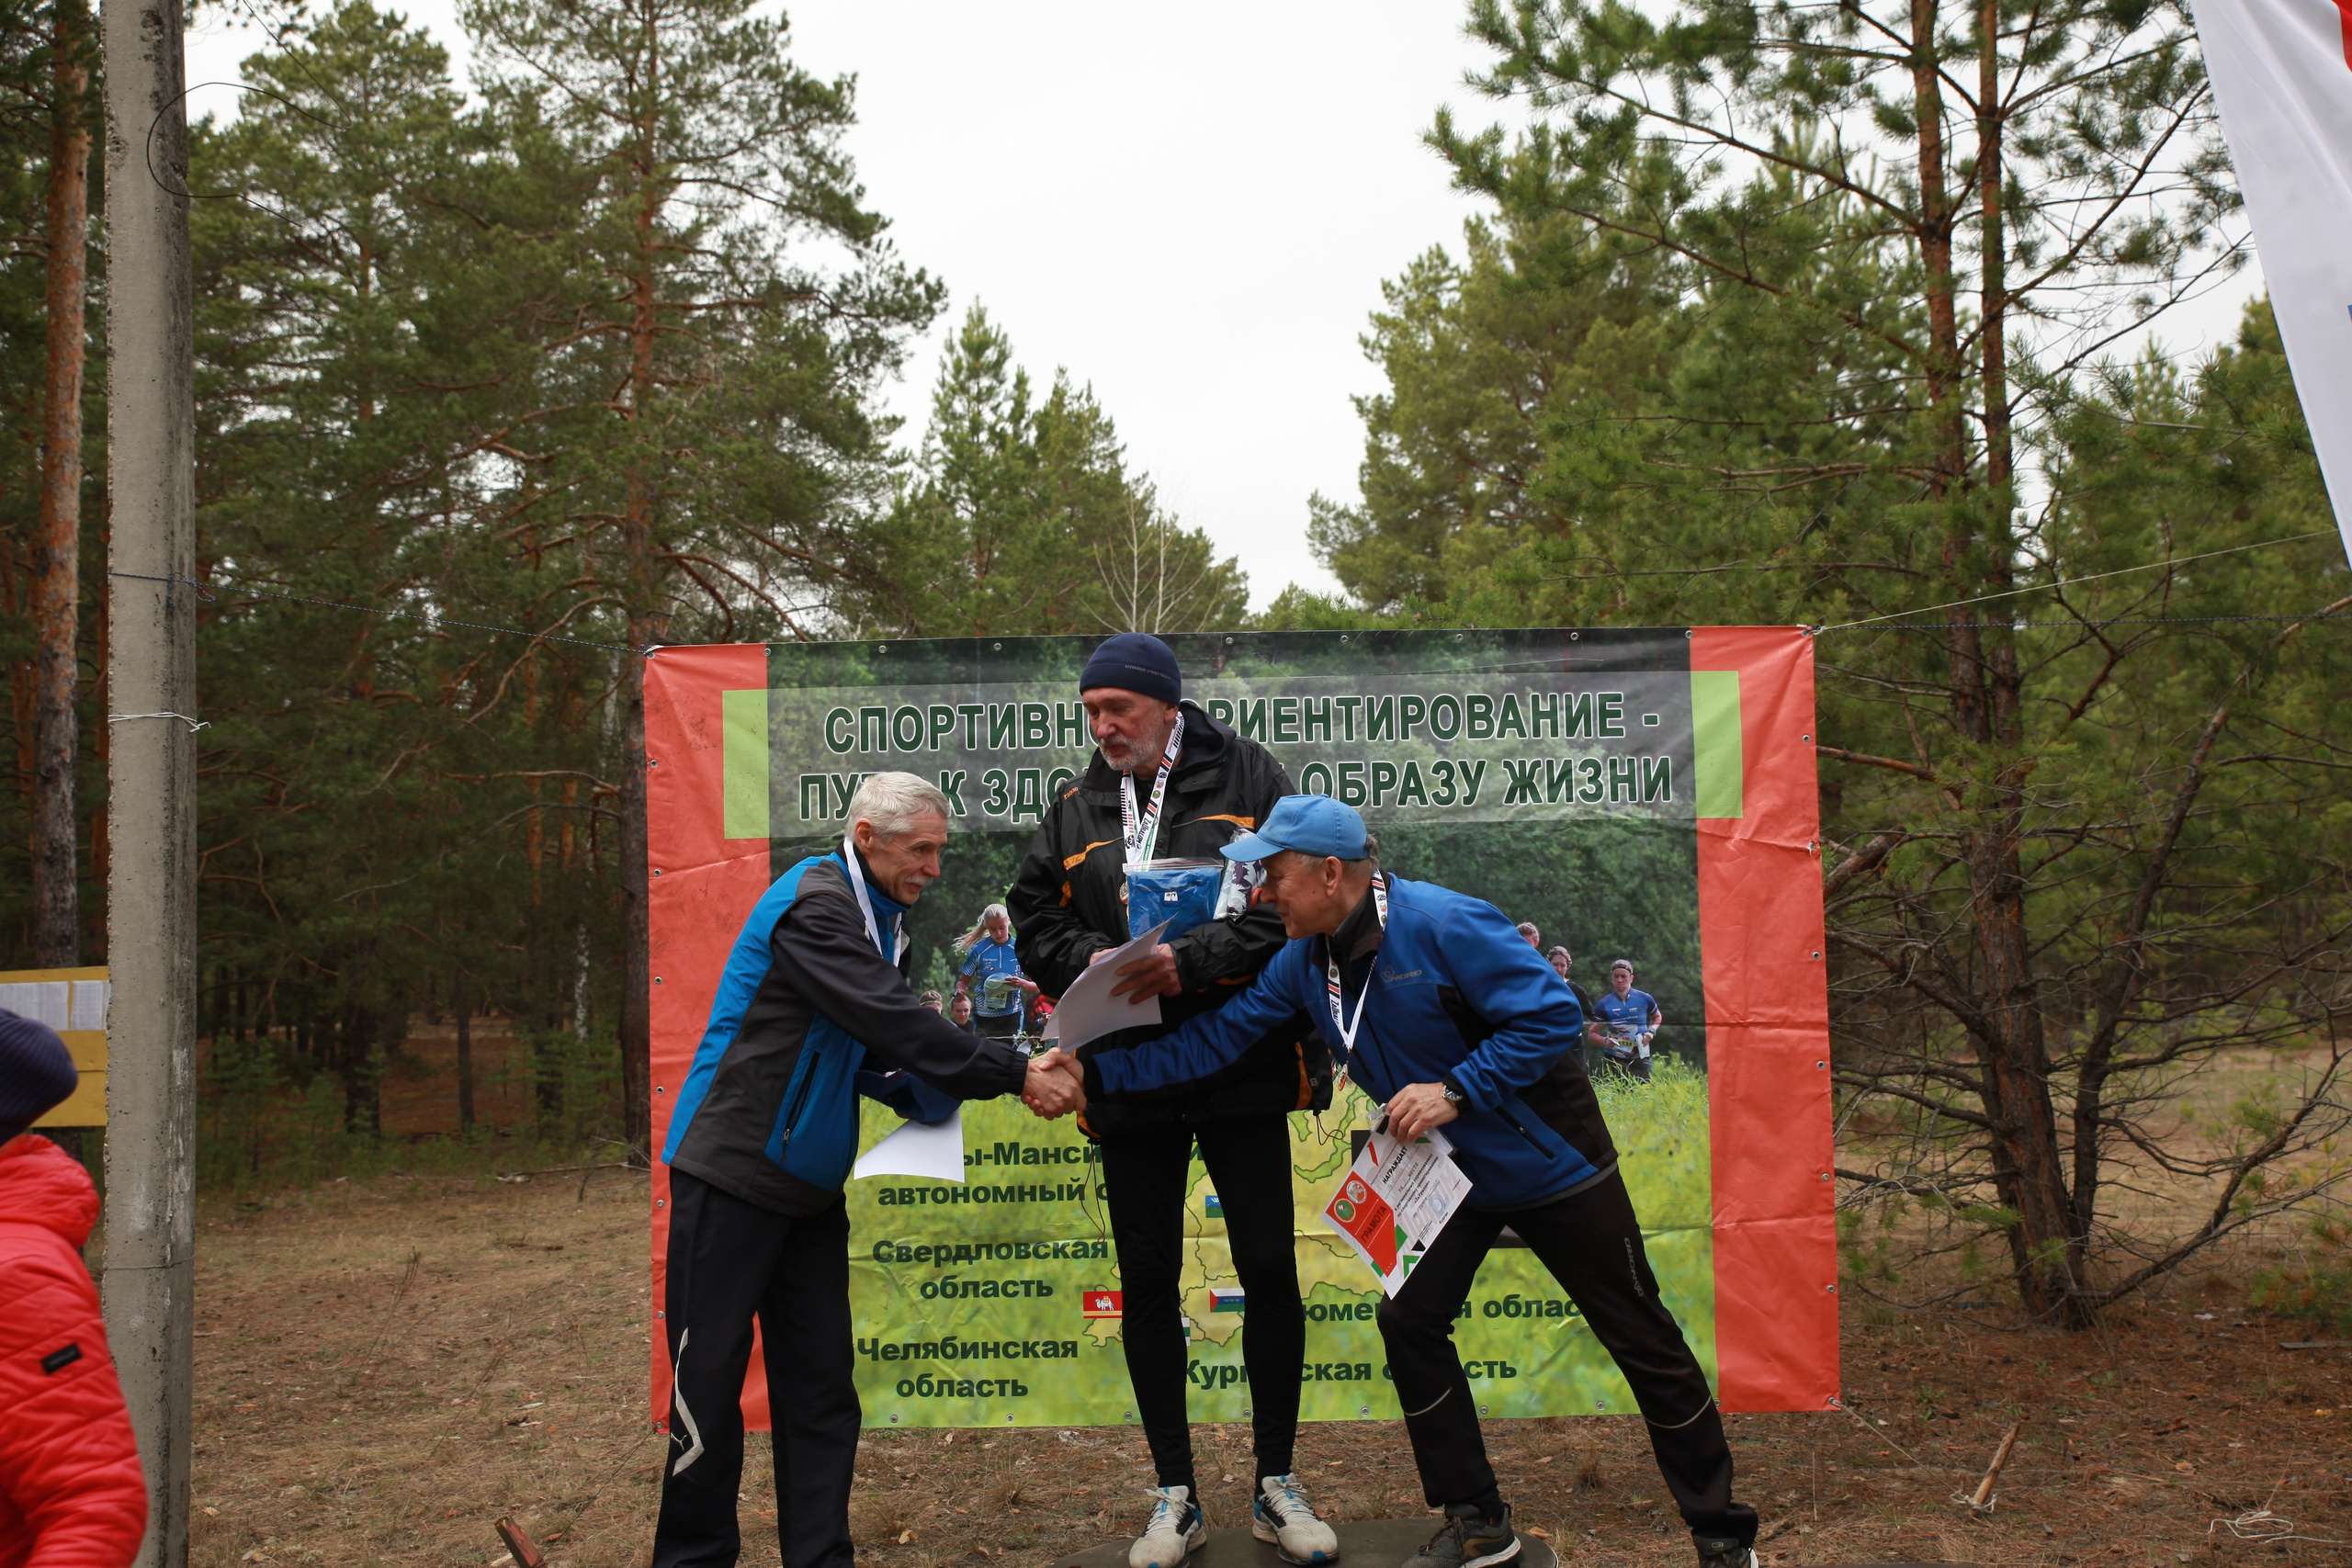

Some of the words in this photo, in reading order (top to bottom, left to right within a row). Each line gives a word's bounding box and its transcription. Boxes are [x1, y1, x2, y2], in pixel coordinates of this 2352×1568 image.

[1181, 691, 1626, 744] РИЕНТИРОВАНИЕ
[800, 773, 877, 821] ПУ
[1300, 760, 1487, 807] ОБРАЗУ
[1502, 756, 1672, 805] ЖИЗНИ
[1390, 969, 1422, 982] NORD
[1382, 1145, 1408, 1185] НАГРАЖДАЕТ
[878, 1178, 1085, 1205] автономный
[1361, 1206, 1387, 1243] ГРАМОТА
[873, 1240, 1109, 1268] Свердловская
[920, 1275, 1054, 1299] область
[1483, 1293, 1582, 1318] облас
[857, 1337, 1079, 1361] Челябинская
[896, 1373, 1028, 1397] область
